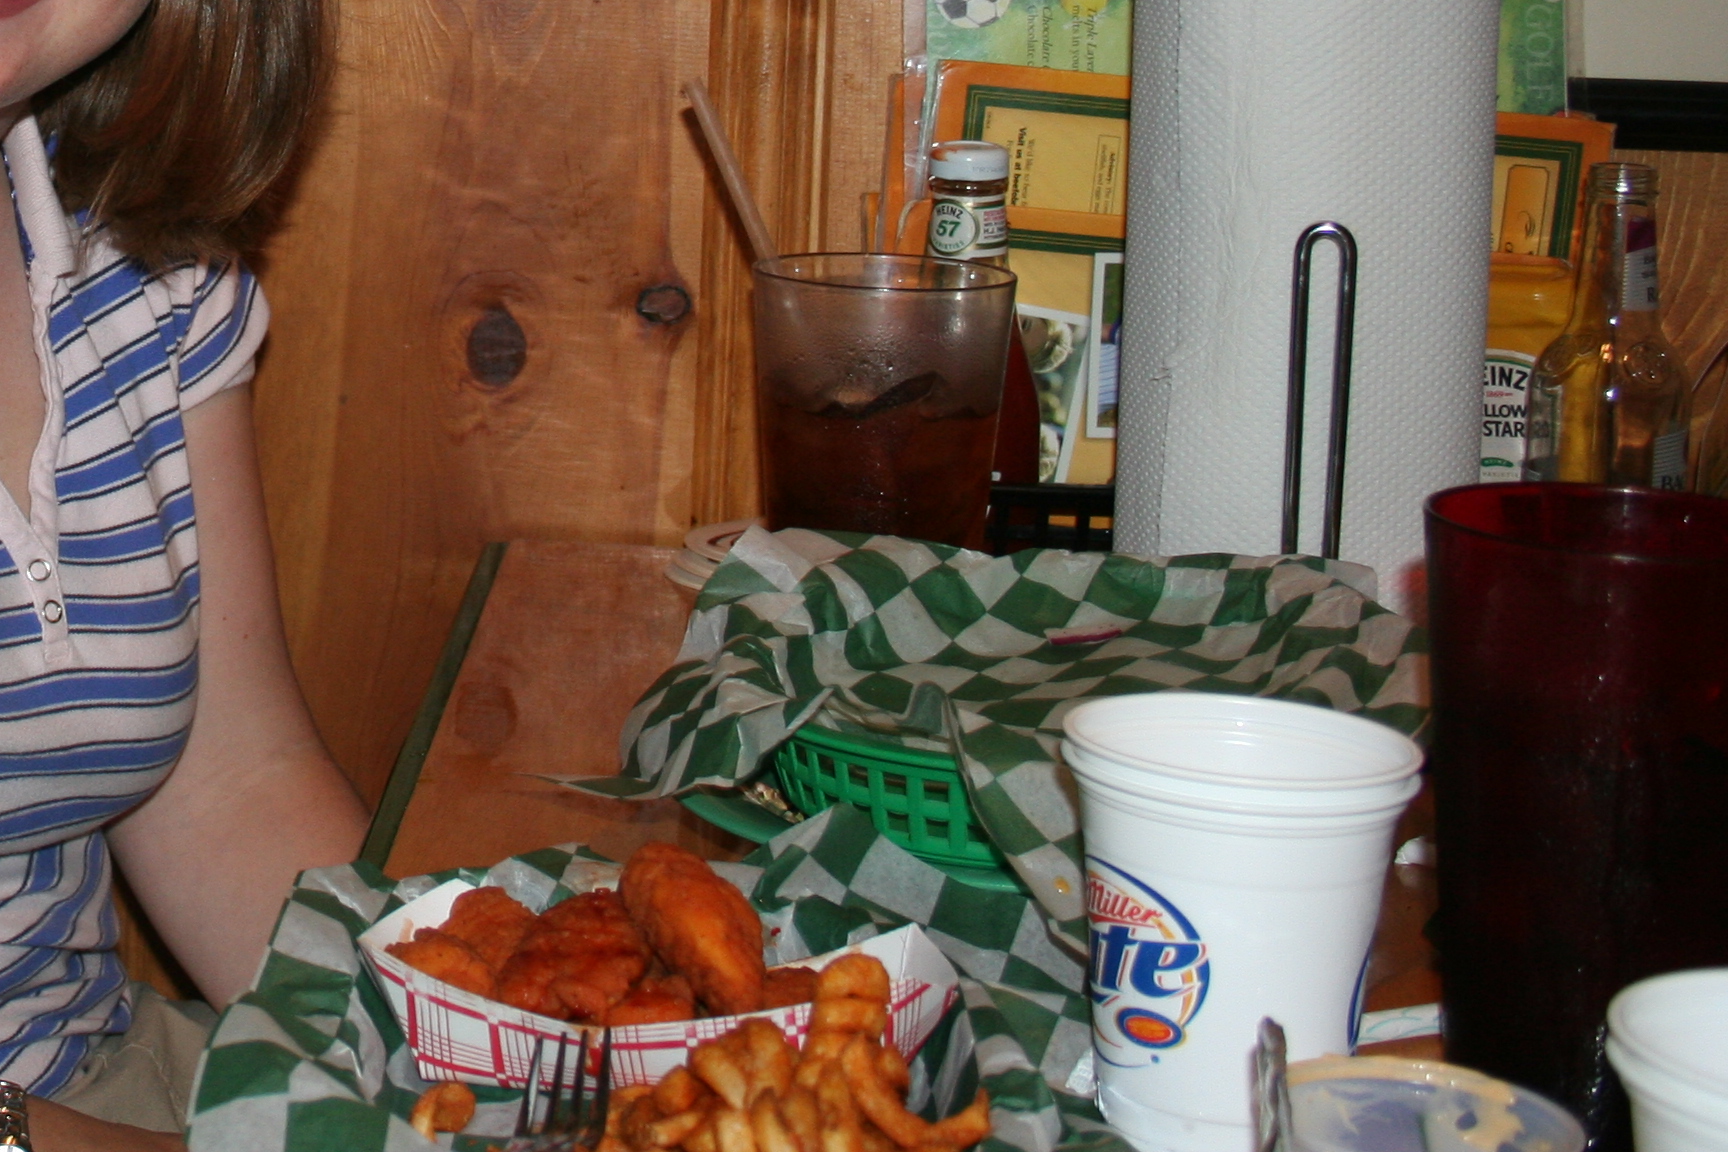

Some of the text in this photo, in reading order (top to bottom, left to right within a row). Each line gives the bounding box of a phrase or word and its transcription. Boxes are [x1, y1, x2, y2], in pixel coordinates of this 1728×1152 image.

[1026, 4, 1039, 59] Chocolate
[1041, 6, 1053, 63] Chocolate
[1081, 7, 1099, 39] Triple
[1524, 4, 1556, 102] GOLF
[1017, 127, 1028, 146] Visit
[936, 205, 963, 219] HEINZ
[936, 220, 961, 238] 57
[1088, 881, 1163, 923] Miller
[1090, 925, 1202, 1003] ite
